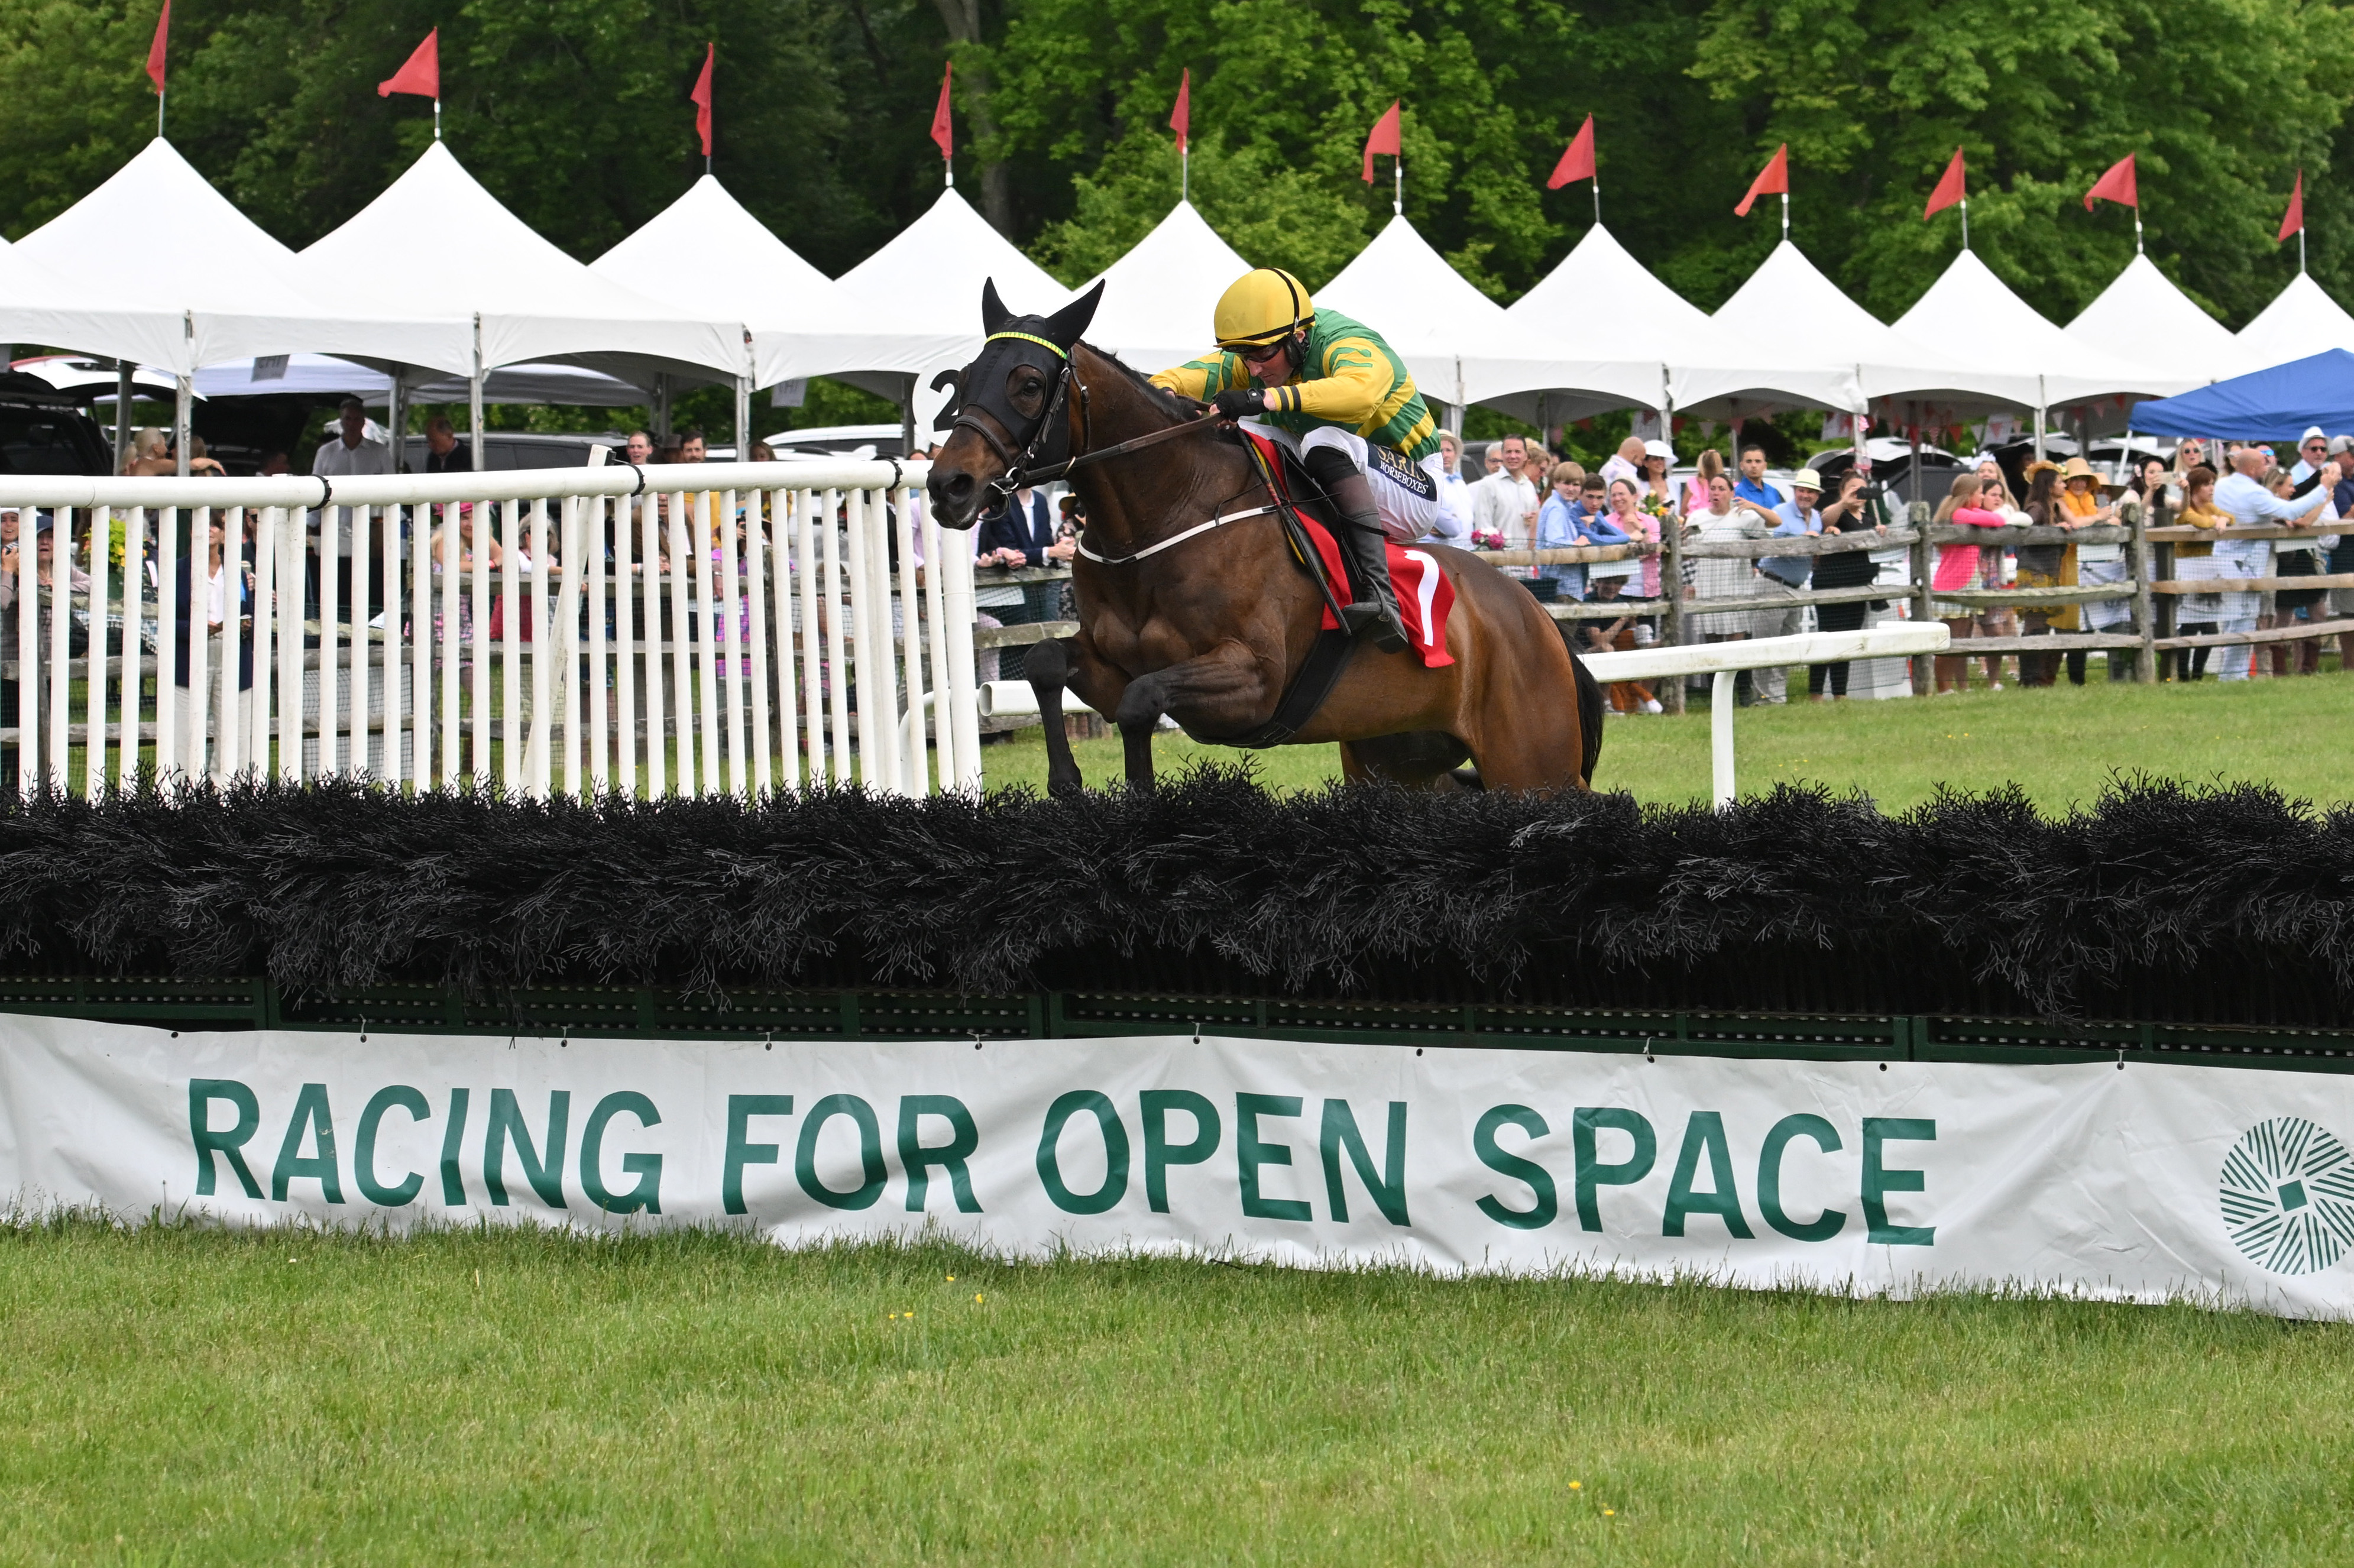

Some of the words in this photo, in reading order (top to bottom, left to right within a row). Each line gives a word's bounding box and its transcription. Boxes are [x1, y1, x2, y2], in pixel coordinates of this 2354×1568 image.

[930, 370, 959, 432] 2
[1380, 460, 1429, 495] HORSEBOXES
[1404, 550, 1440, 646] 1
[190, 1078, 662, 1214] RACING
[723, 1093, 984, 1214] FOR
[1036, 1089, 1412, 1227] OPEN
[1473, 1103, 1937, 1246] SPACE
